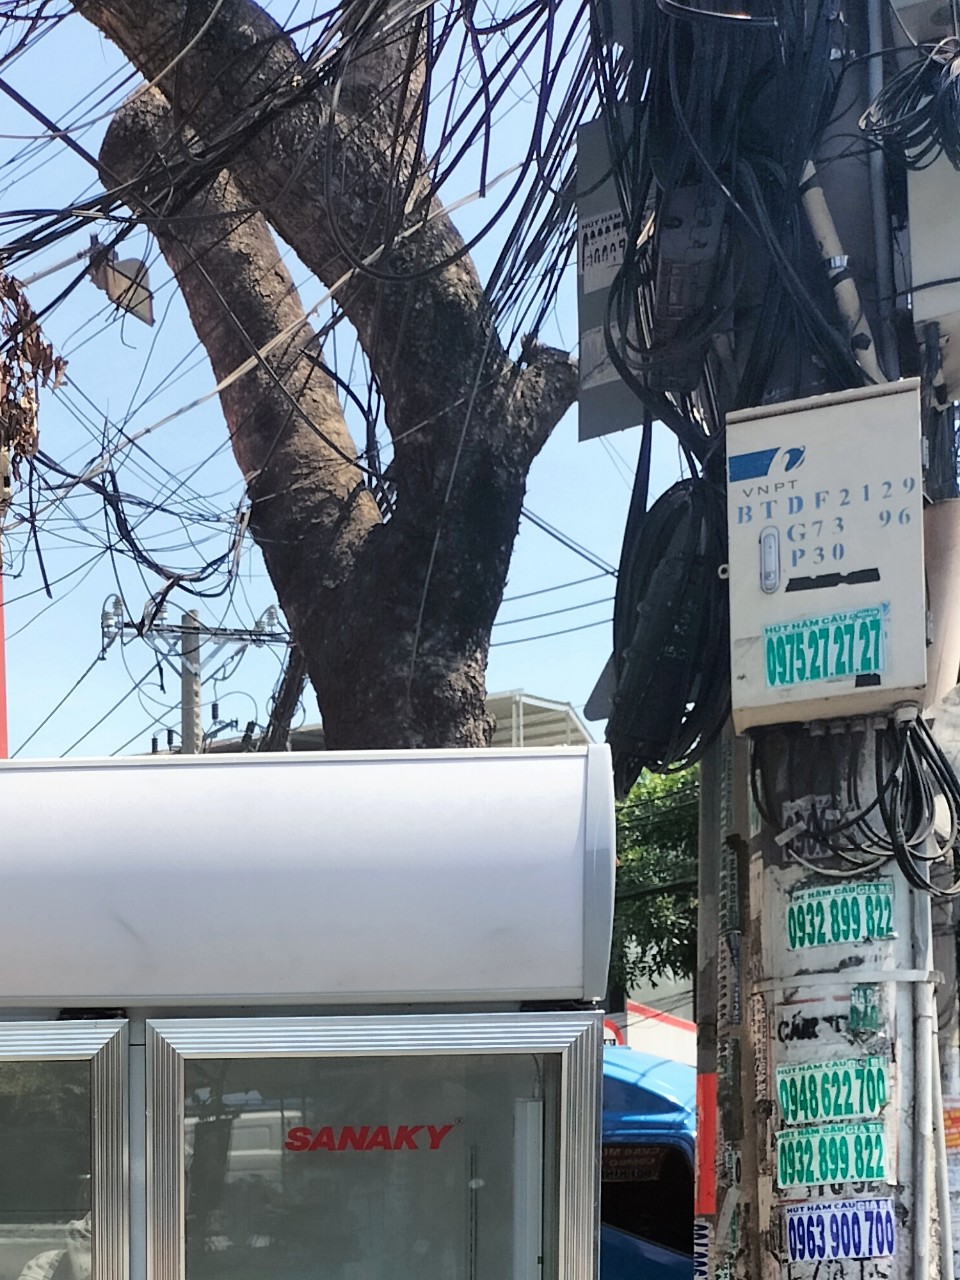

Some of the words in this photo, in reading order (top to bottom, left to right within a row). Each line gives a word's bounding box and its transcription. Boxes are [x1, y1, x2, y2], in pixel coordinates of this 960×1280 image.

[742, 480, 798, 498] VNPT
[786, 516, 845, 543] G73
[879, 507, 911, 528] 96
[791, 542, 845, 567] P30
[285, 1124, 455, 1152] SANAKY
[779, 1133, 885, 1185] 0932.899.822
[788, 1210, 895, 1261] 0963.900.700
